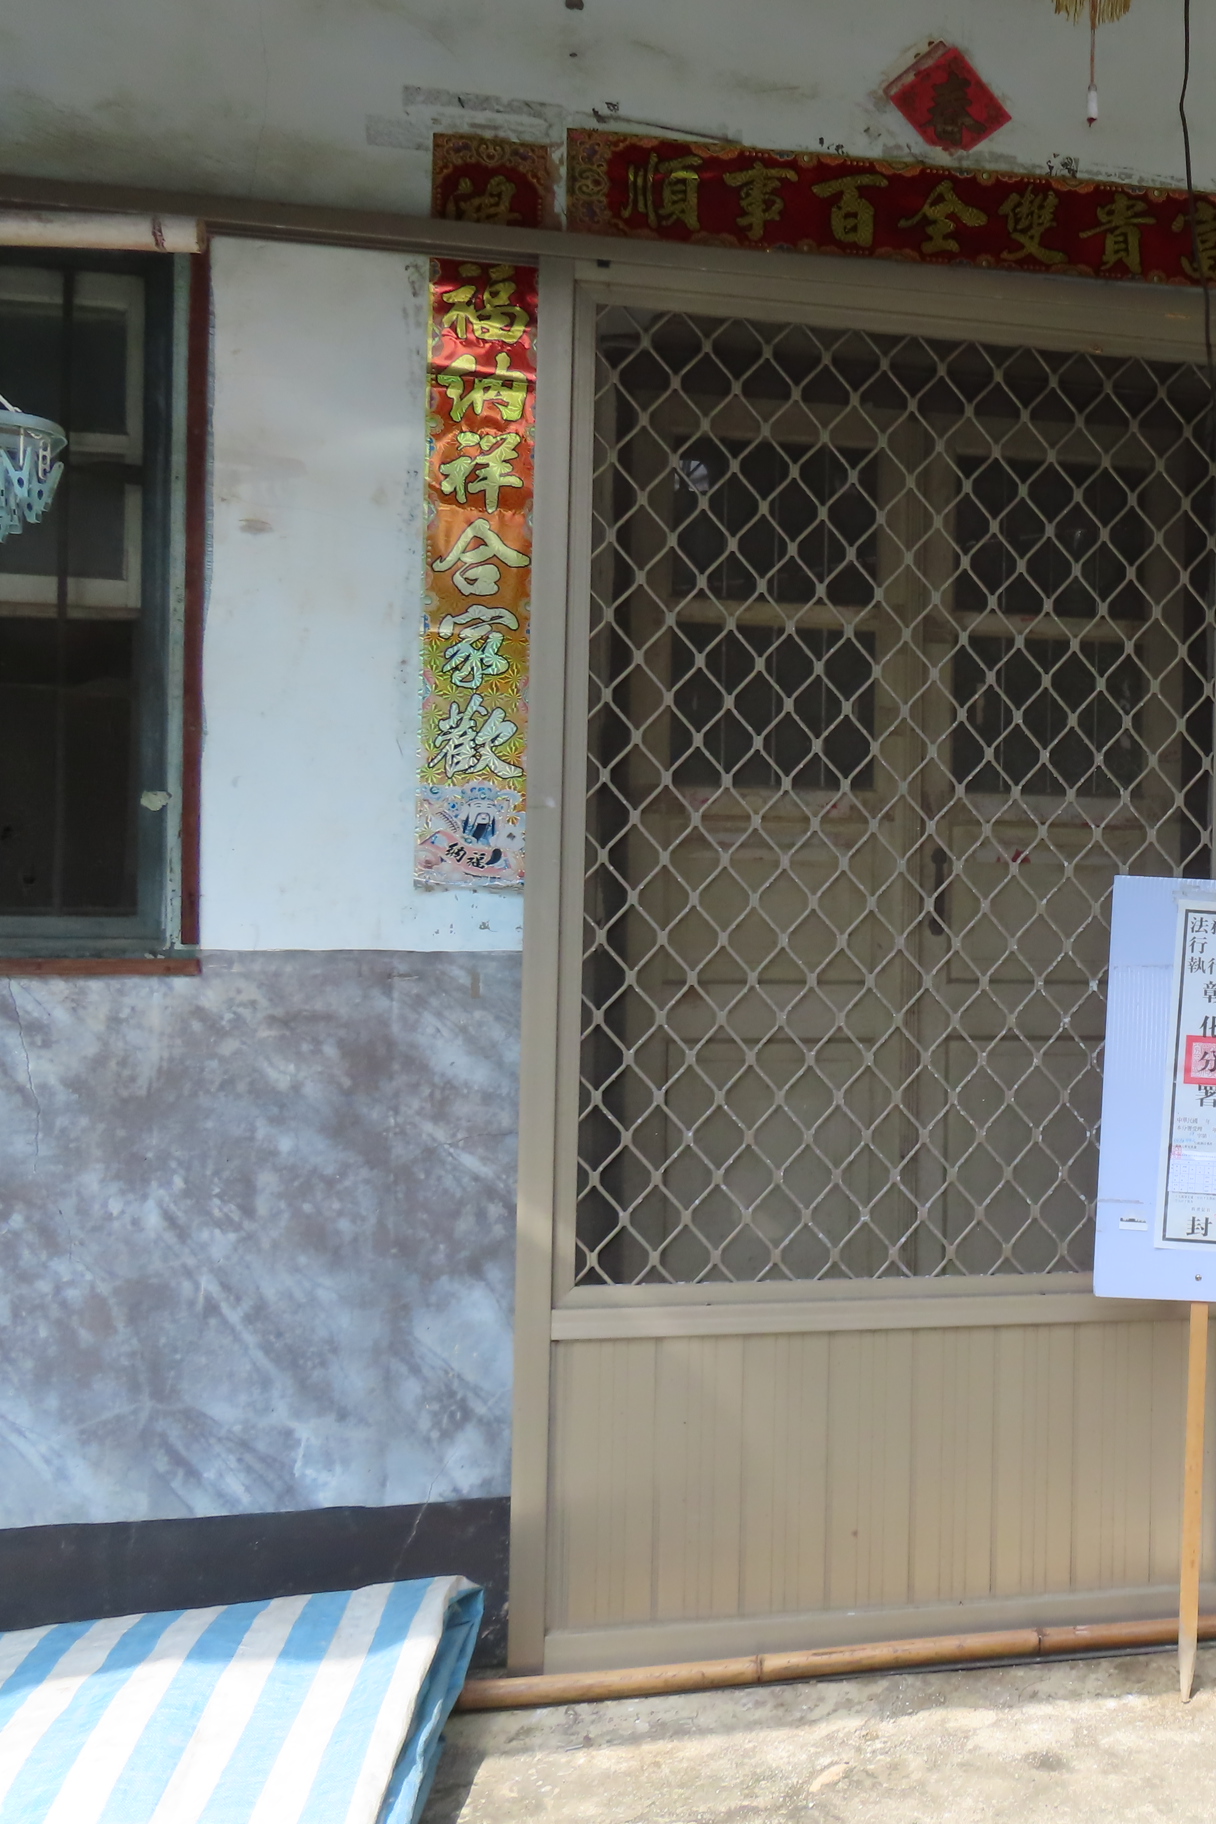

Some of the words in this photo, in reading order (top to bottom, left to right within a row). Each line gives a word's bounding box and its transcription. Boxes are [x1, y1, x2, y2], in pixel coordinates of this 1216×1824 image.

[918, 70, 987, 146] 春
[444, 842, 488, 870] 納福
[1185, 1215, 1213, 1237] 封
